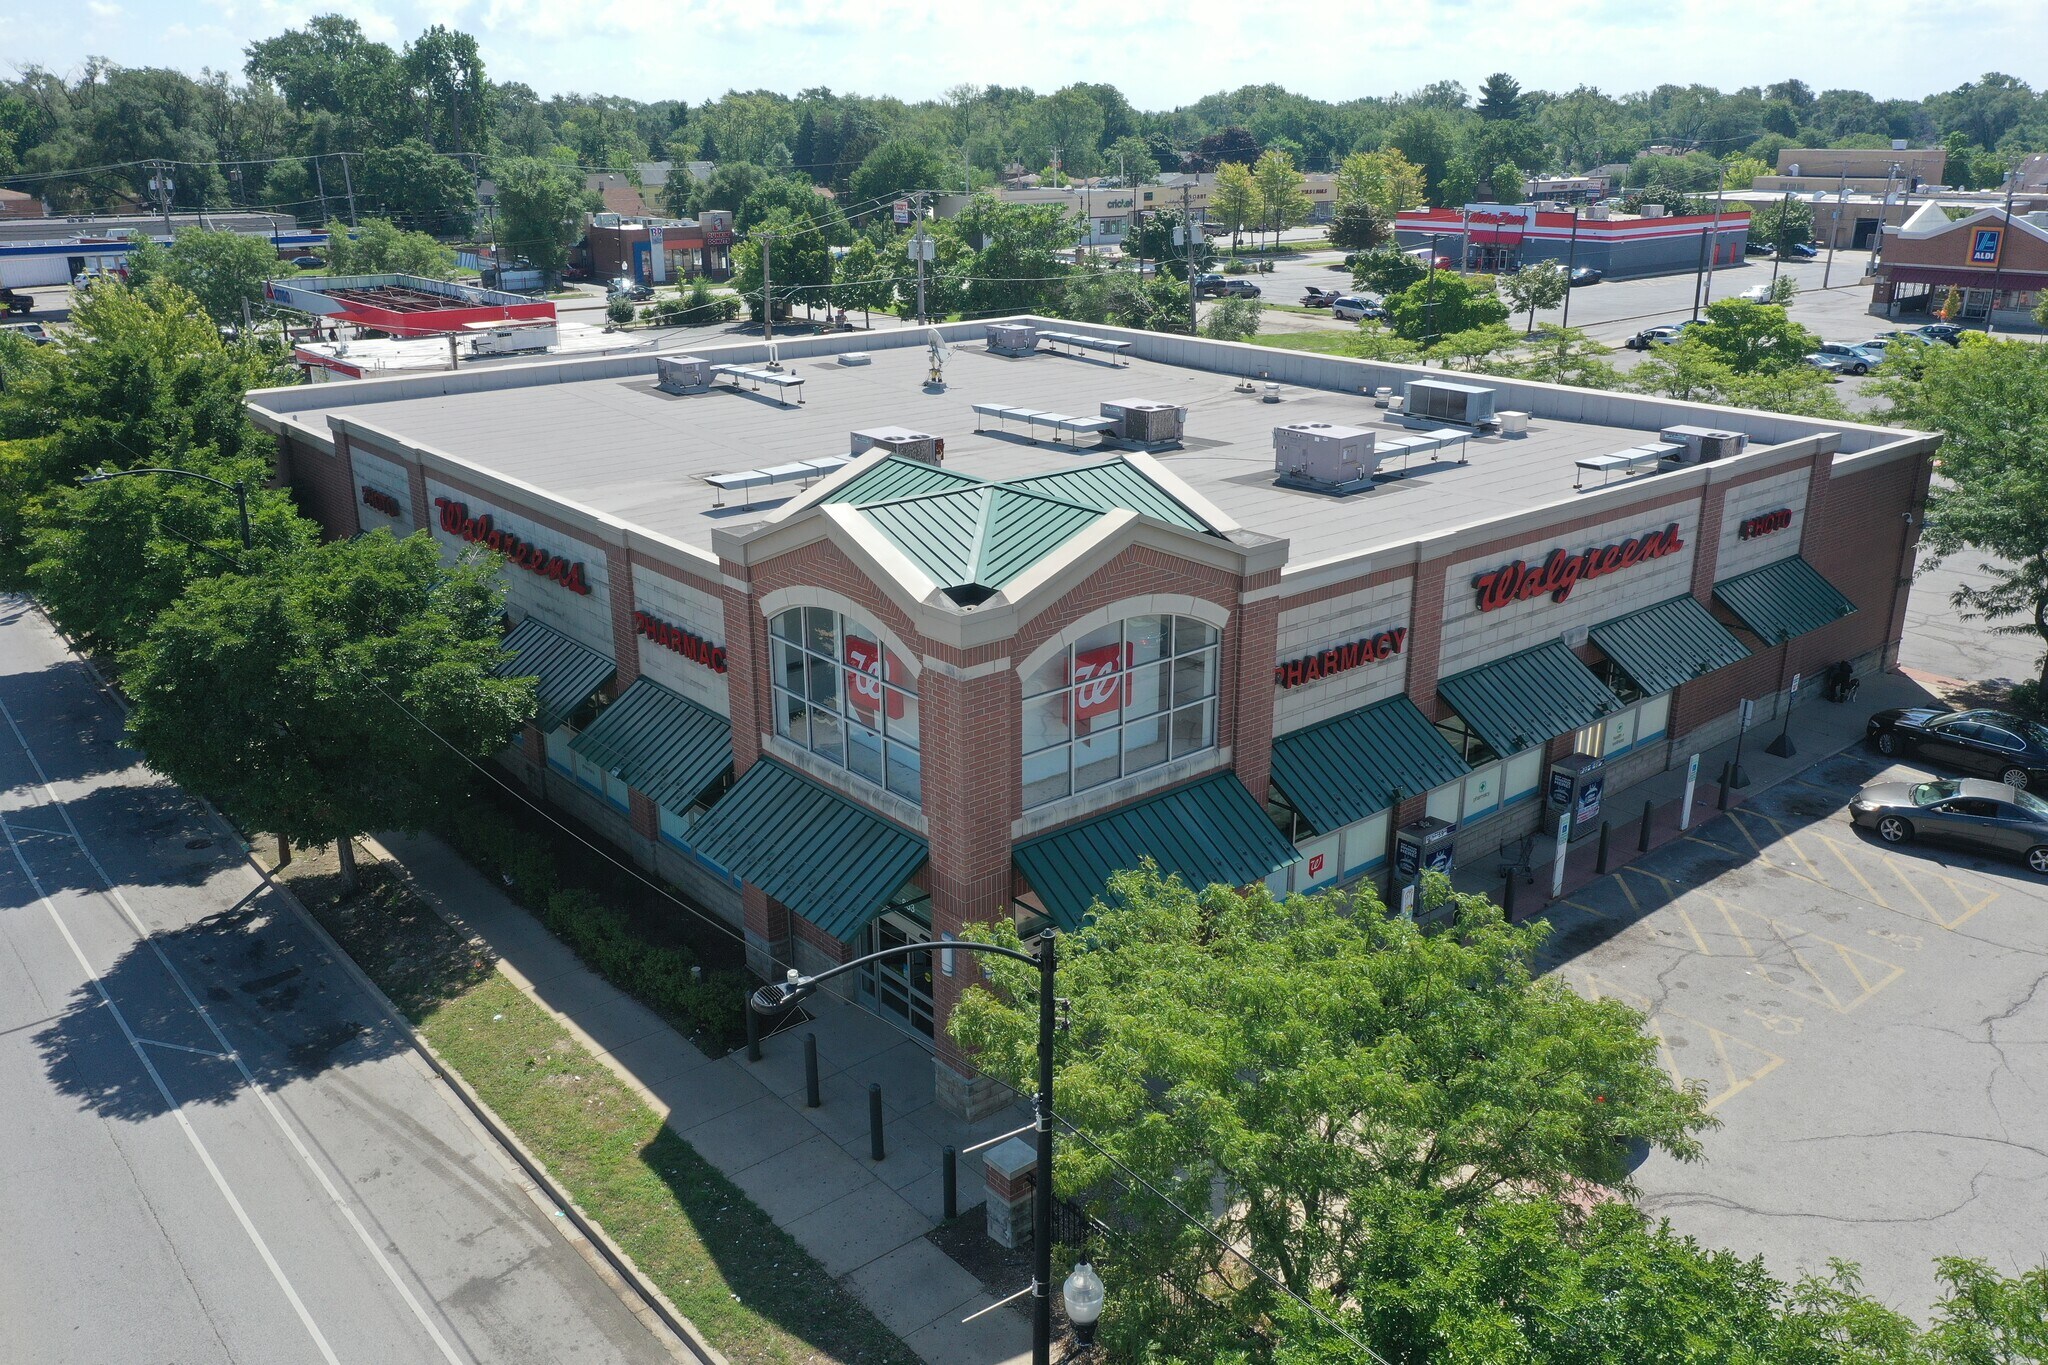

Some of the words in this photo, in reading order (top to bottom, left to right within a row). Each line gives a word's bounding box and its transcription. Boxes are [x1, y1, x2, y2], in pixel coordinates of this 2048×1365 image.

[1106, 198, 1134, 209] cricket
[1469, 211, 1528, 225] AutoZone
[1974, 252, 1995, 260] ALDI
[1739, 508, 1793, 541] PHOTO
[1471, 522, 1684, 613] Walgreens
[633, 610, 728, 674] PHARMAC
[1274, 626, 1408, 690] PHARMACY
